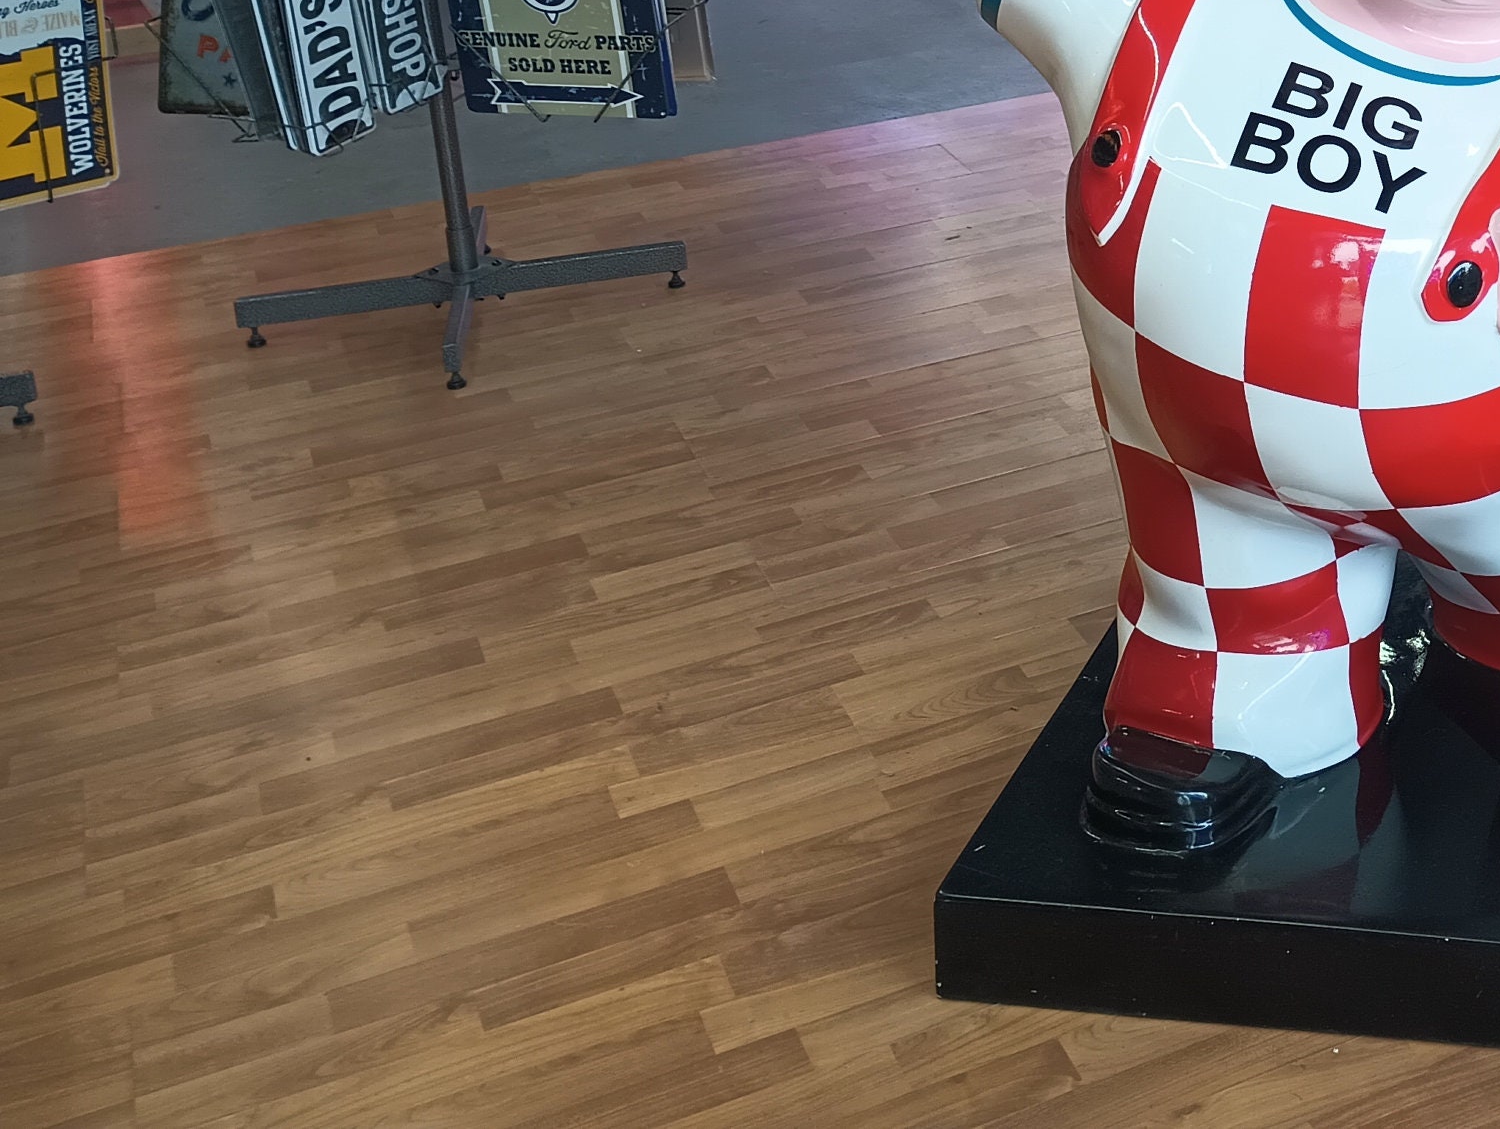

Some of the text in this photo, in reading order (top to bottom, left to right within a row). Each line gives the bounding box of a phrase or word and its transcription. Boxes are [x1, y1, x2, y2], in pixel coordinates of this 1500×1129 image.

[456, 30, 657, 54] GENUINE Ford PARTS
[508, 57, 612, 75] SOLD HERE
[58, 43, 95, 176] WOLVERINES
[1271, 61, 1423, 151] BIG
[1230, 111, 1428, 215] BOY
